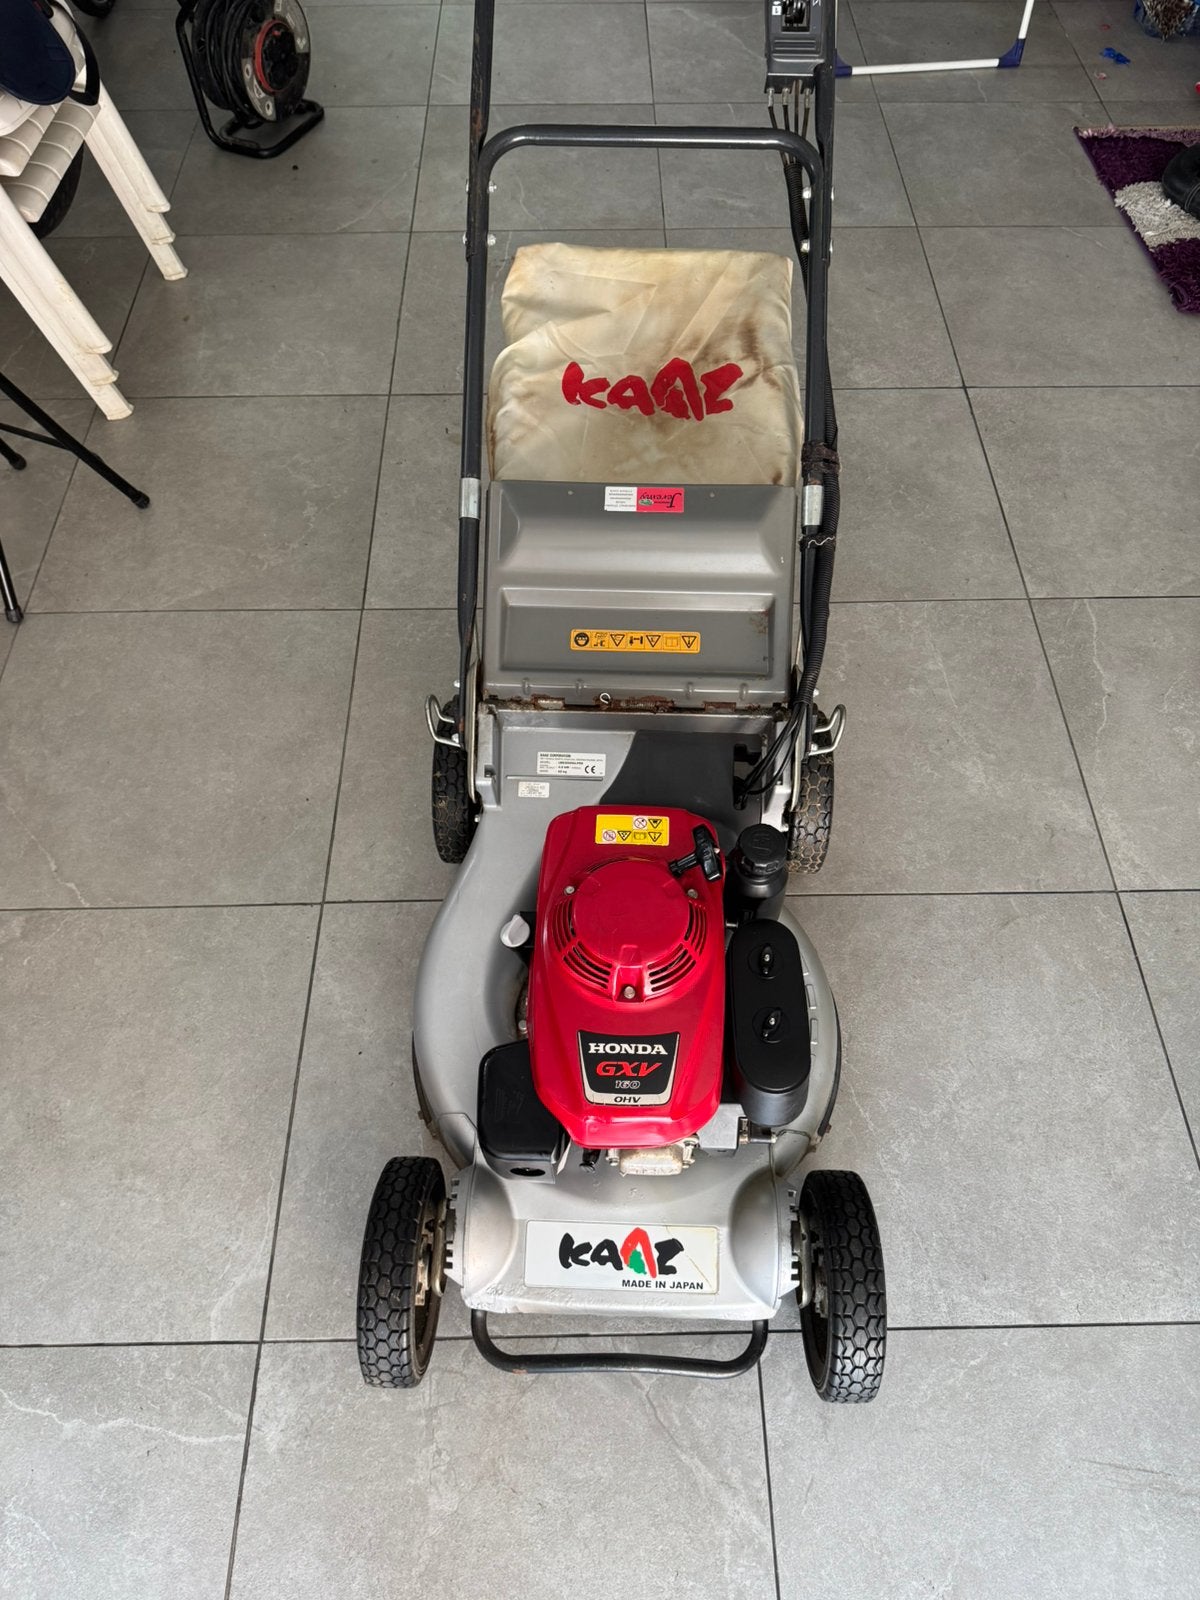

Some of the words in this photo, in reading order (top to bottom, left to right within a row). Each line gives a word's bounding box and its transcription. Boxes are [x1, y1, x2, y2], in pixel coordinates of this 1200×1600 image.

[639, 491, 682, 509] Jeremy
[584, 765, 596, 774] CE
[588, 1042, 668, 1055] HONDA
[595, 1061, 663, 1077] GXV
[614, 1080, 641, 1090] 160
[613, 1096, 642, 1104] OHV
[621, 1279, 652, 1289] MADE
[655, 1280, 666, 1289] IN
[669, 1281, 704, 1290] JAPAN
